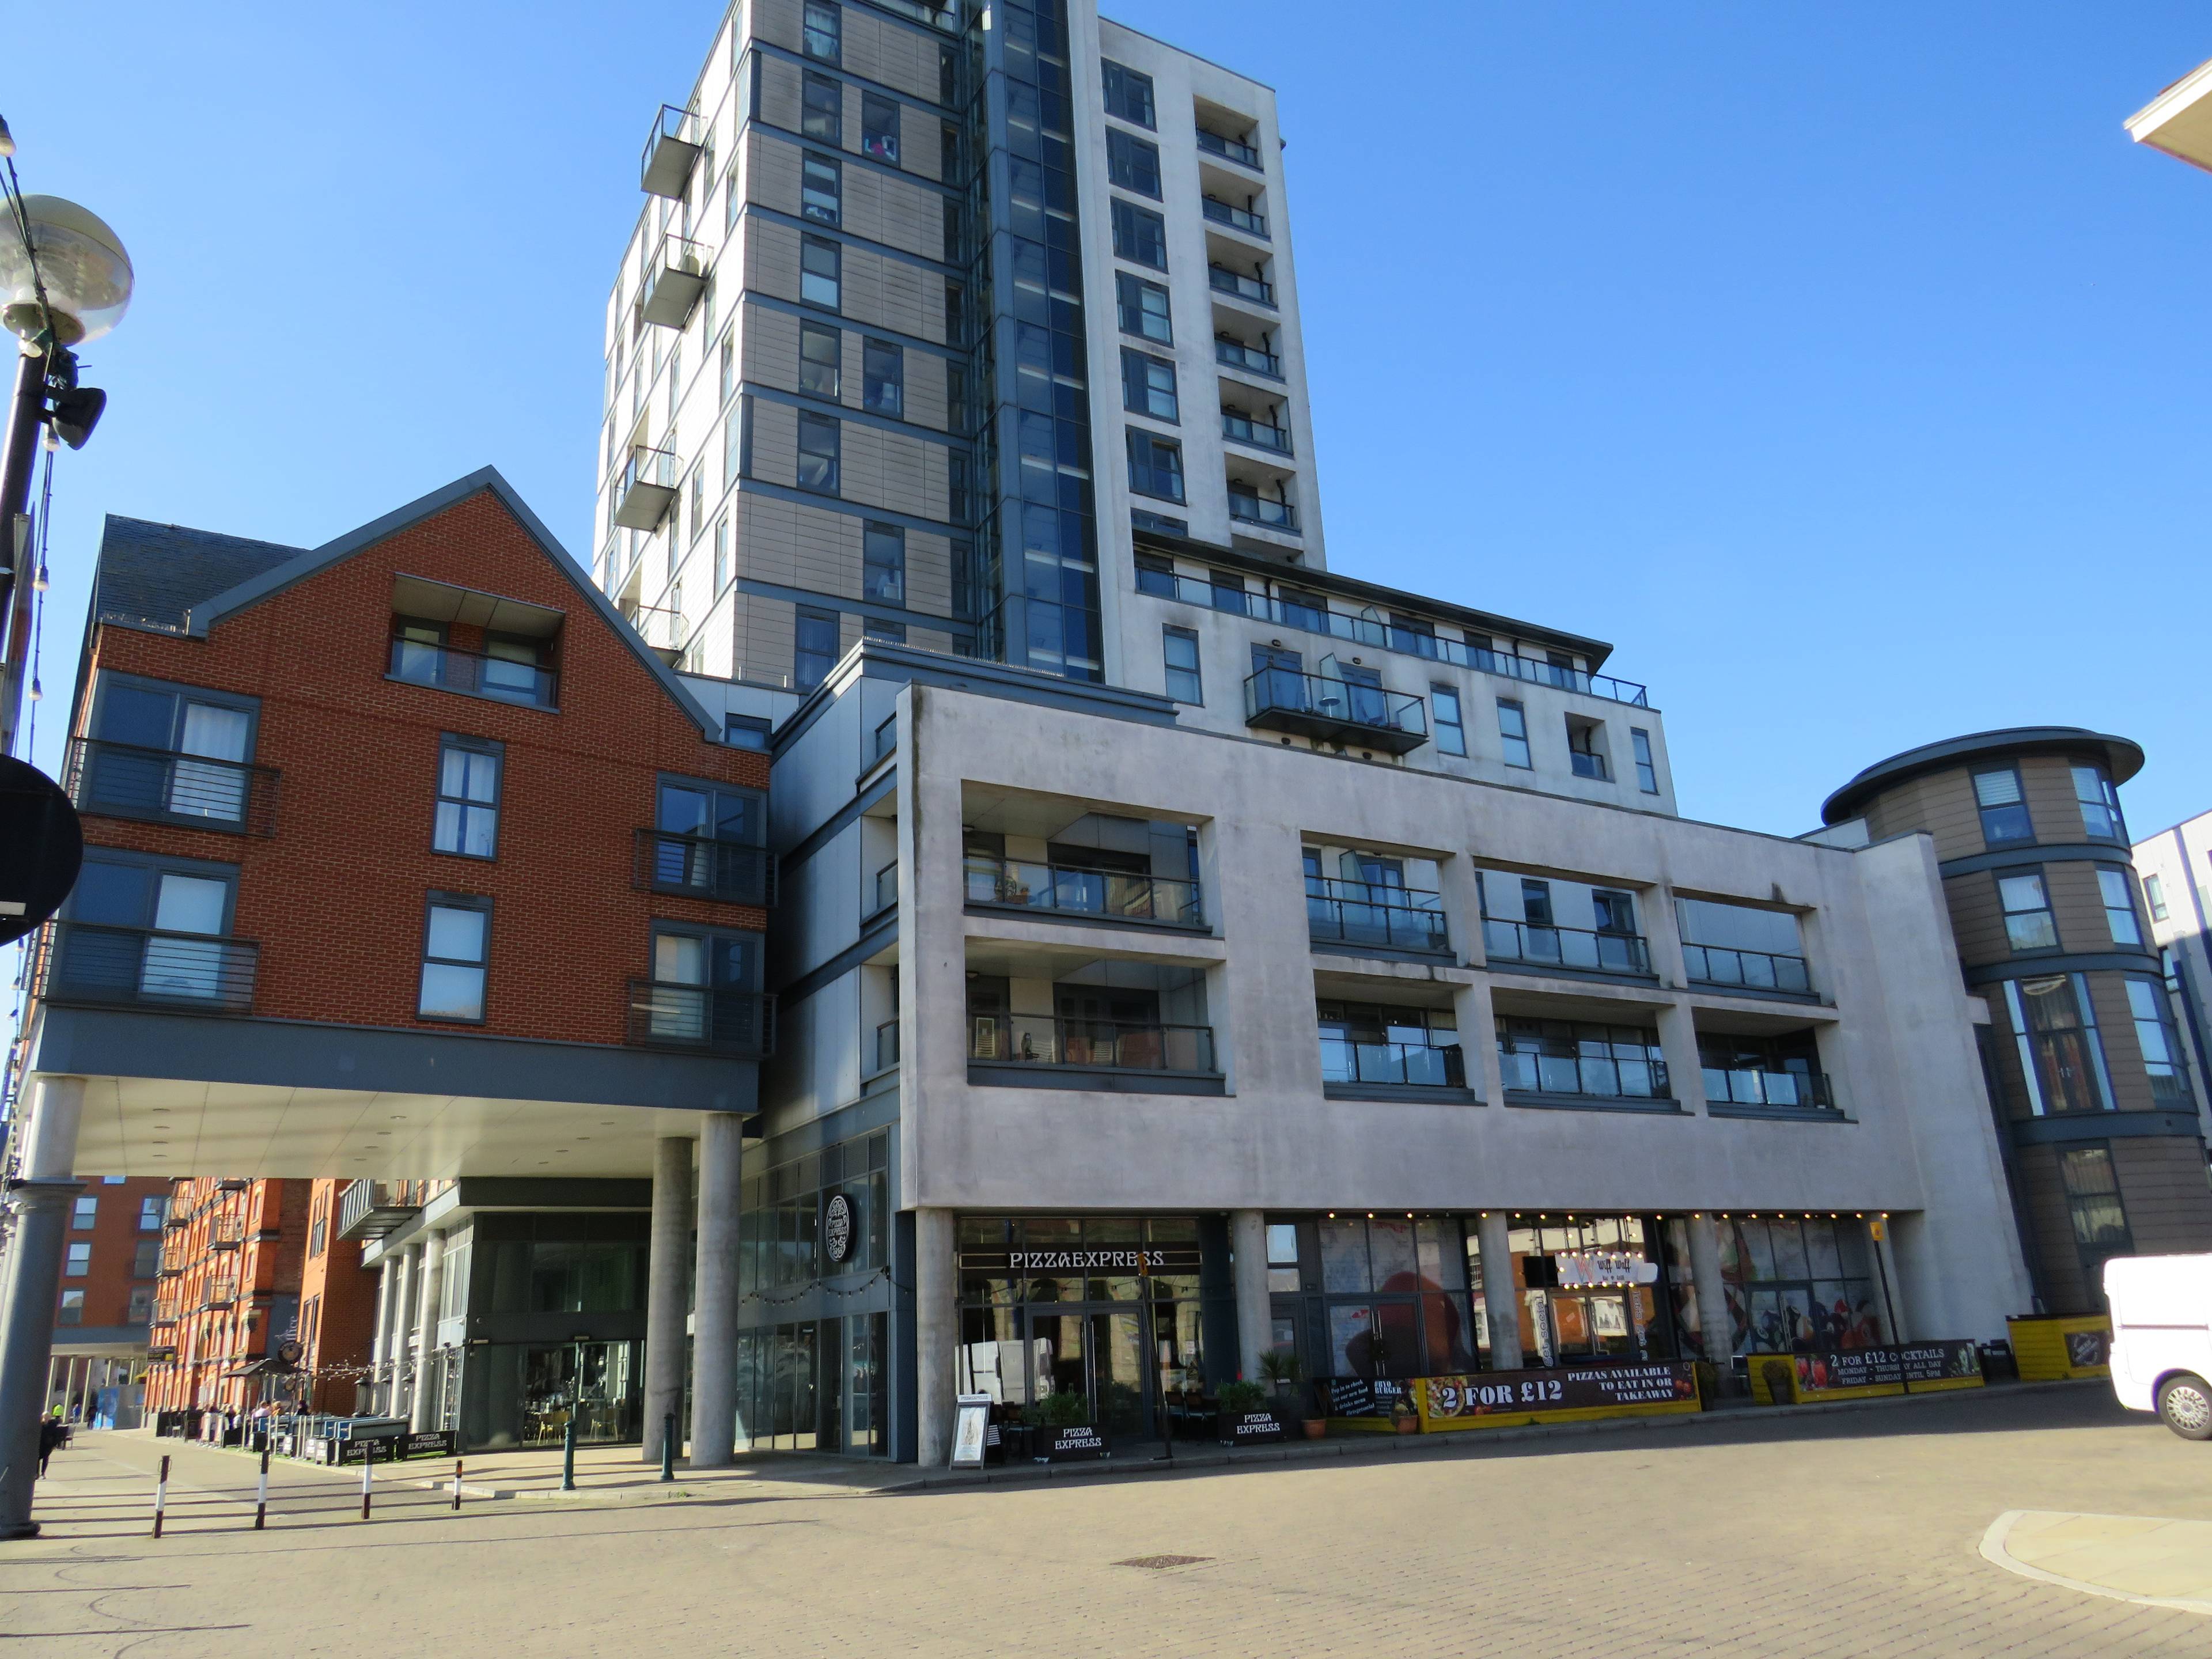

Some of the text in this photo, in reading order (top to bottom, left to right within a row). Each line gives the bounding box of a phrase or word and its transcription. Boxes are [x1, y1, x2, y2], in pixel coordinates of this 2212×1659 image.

[1010, 1251, 1164, 1268] PIZZAEXPRESS
[1597, 1258, 1612, 1274] Wiff
[1535, 1296, 1548, 1338] social
[1830, 1354, 1838, 1367] 2
[1842, 1356, 1862, 1366] FOR
[1865, 1351, 1886, 1364] £12
[1567, 1366, 1671, 1381] PIZZAS AVAILABLE
[1838, 1366, 1866, 1376] MONDAY
[1876, 1361, 1910, 1372] THURSY
[1599, 1377, 1673, 1391] TO EAT IN OR
[1842, 1376, 1866, 1384] FRIDAY
[1874, 1373, 1901, 1382] SUNDAY
[1442, 1380, 1562, 1408] 2 FOR £12
[1615, 1389, 1673, 1401] TAKEAWAY
[1244, 1413, 1272, 1423] PIZZA
[1063, 1427, 1093, 1438] PIZZA
[1237, 1423, 1280, 1434] EXPRESS
[416, 1433, 440, 1441] PIZZA
[408, 1440, 447, 1450] EXPRESS
[1055, 1438, 1101, 1450] EXPRESS
